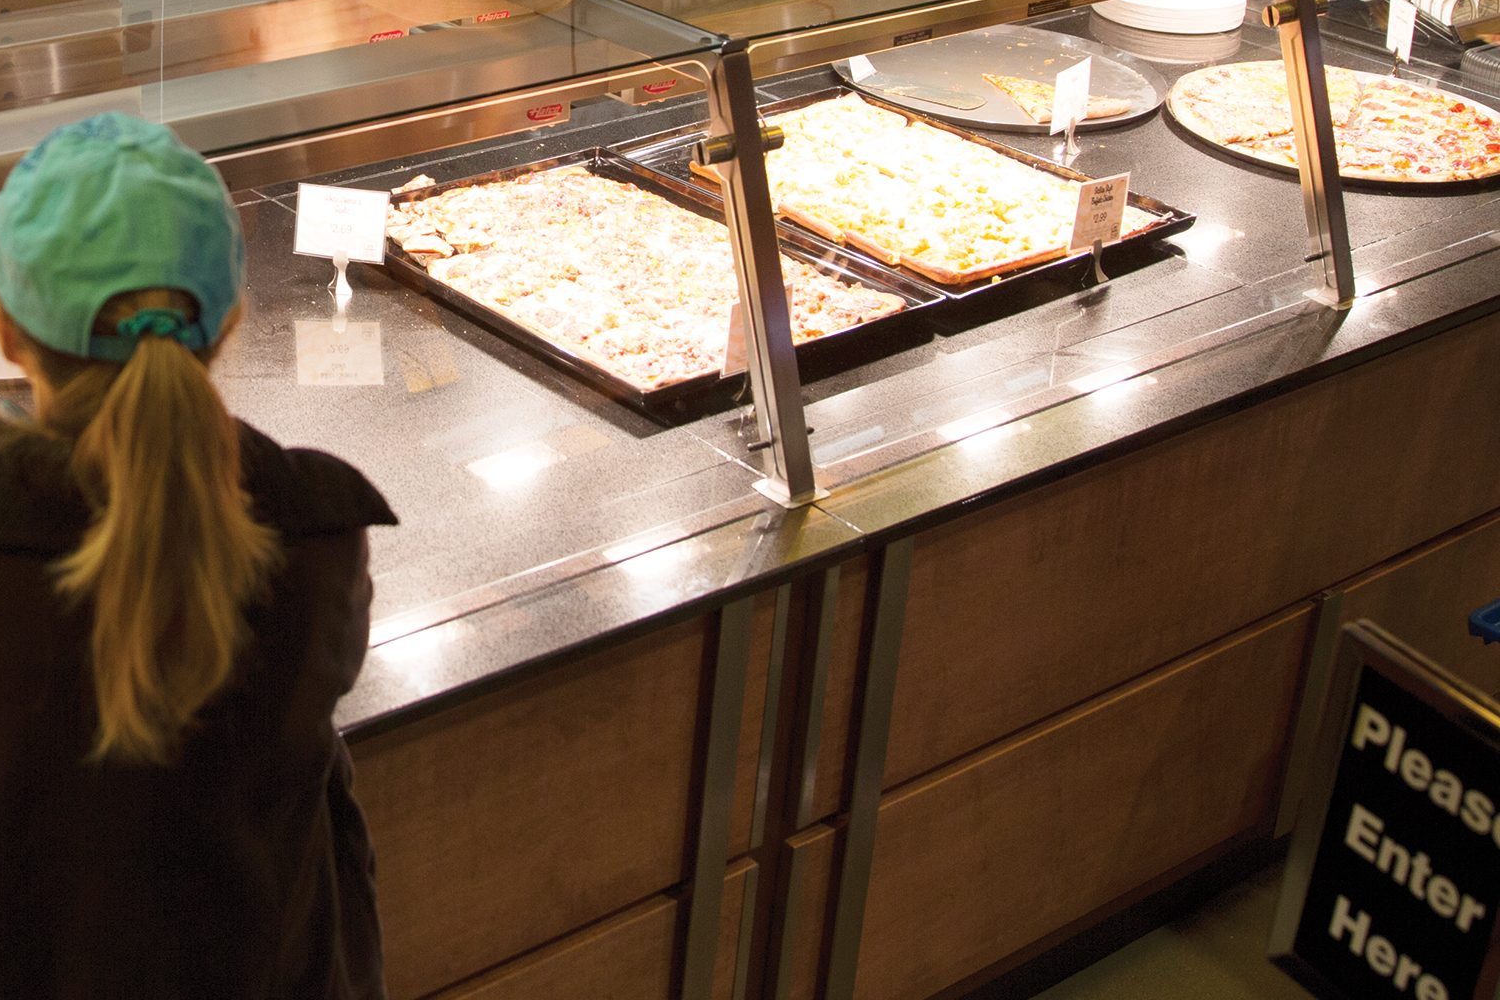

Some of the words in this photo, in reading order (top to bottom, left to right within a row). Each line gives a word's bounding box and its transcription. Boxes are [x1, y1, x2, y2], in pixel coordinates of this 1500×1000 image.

[1351, 702, 1500, 850] Pleas
[1345, 803, 1486, 933] Enter
[1328, 895, 1450, 1000] Here
